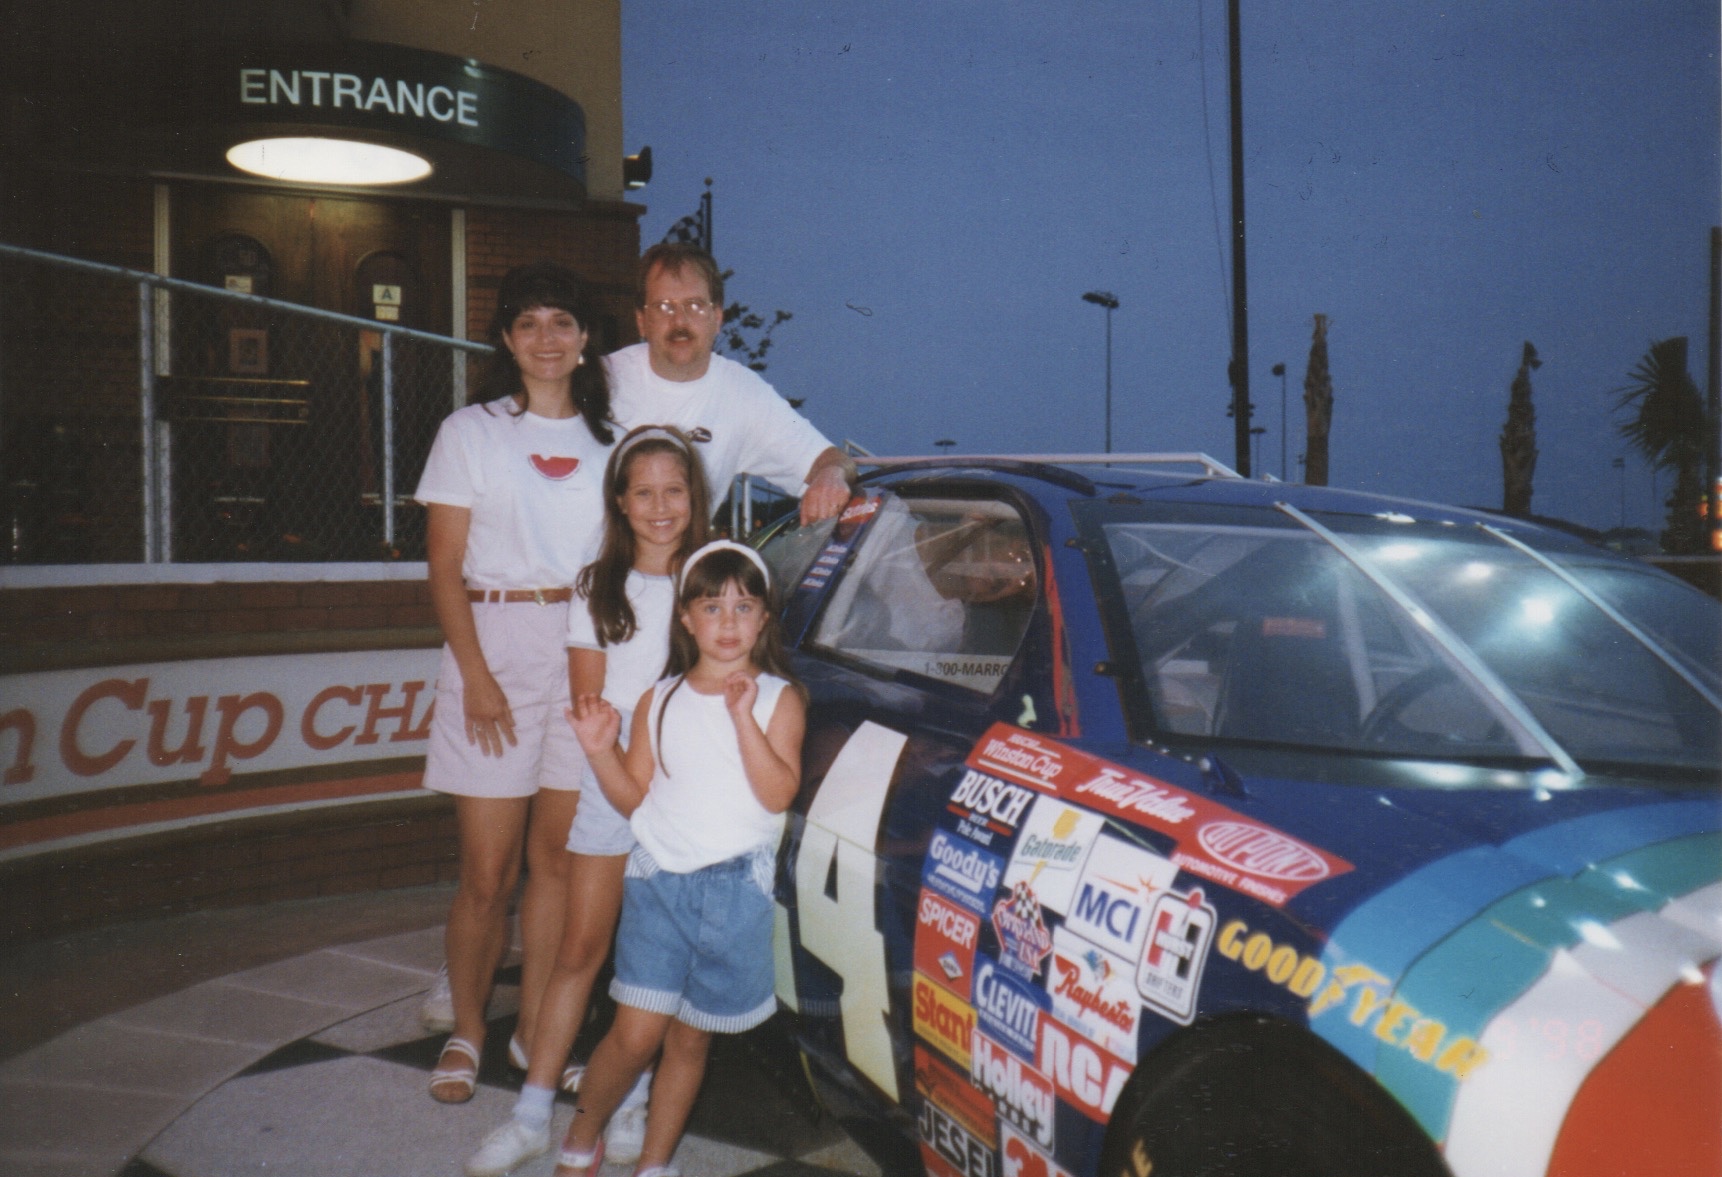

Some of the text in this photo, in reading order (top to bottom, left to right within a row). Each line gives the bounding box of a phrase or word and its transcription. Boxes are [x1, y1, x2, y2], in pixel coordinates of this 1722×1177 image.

[240, 69, 479, 127] ENTRANCE
[381, 287, 393, 300] A
[59, 677, 284, 785] Cup
[1030, 755, 1063, 780] Cup
[950, 769, 1034, 828] BUSCH
[930, 834, 1000, 892] Goody's
[1021, 834, 1081, 862] Gatorade
[774, 719, 908, 1103] 4
[919, 898, 975, 950] SPICER
[1075, 882, 1140, 943] MCI
[916, 981, 973, 1050] Stant
[974, 1032, 1054, 1147] Holley
